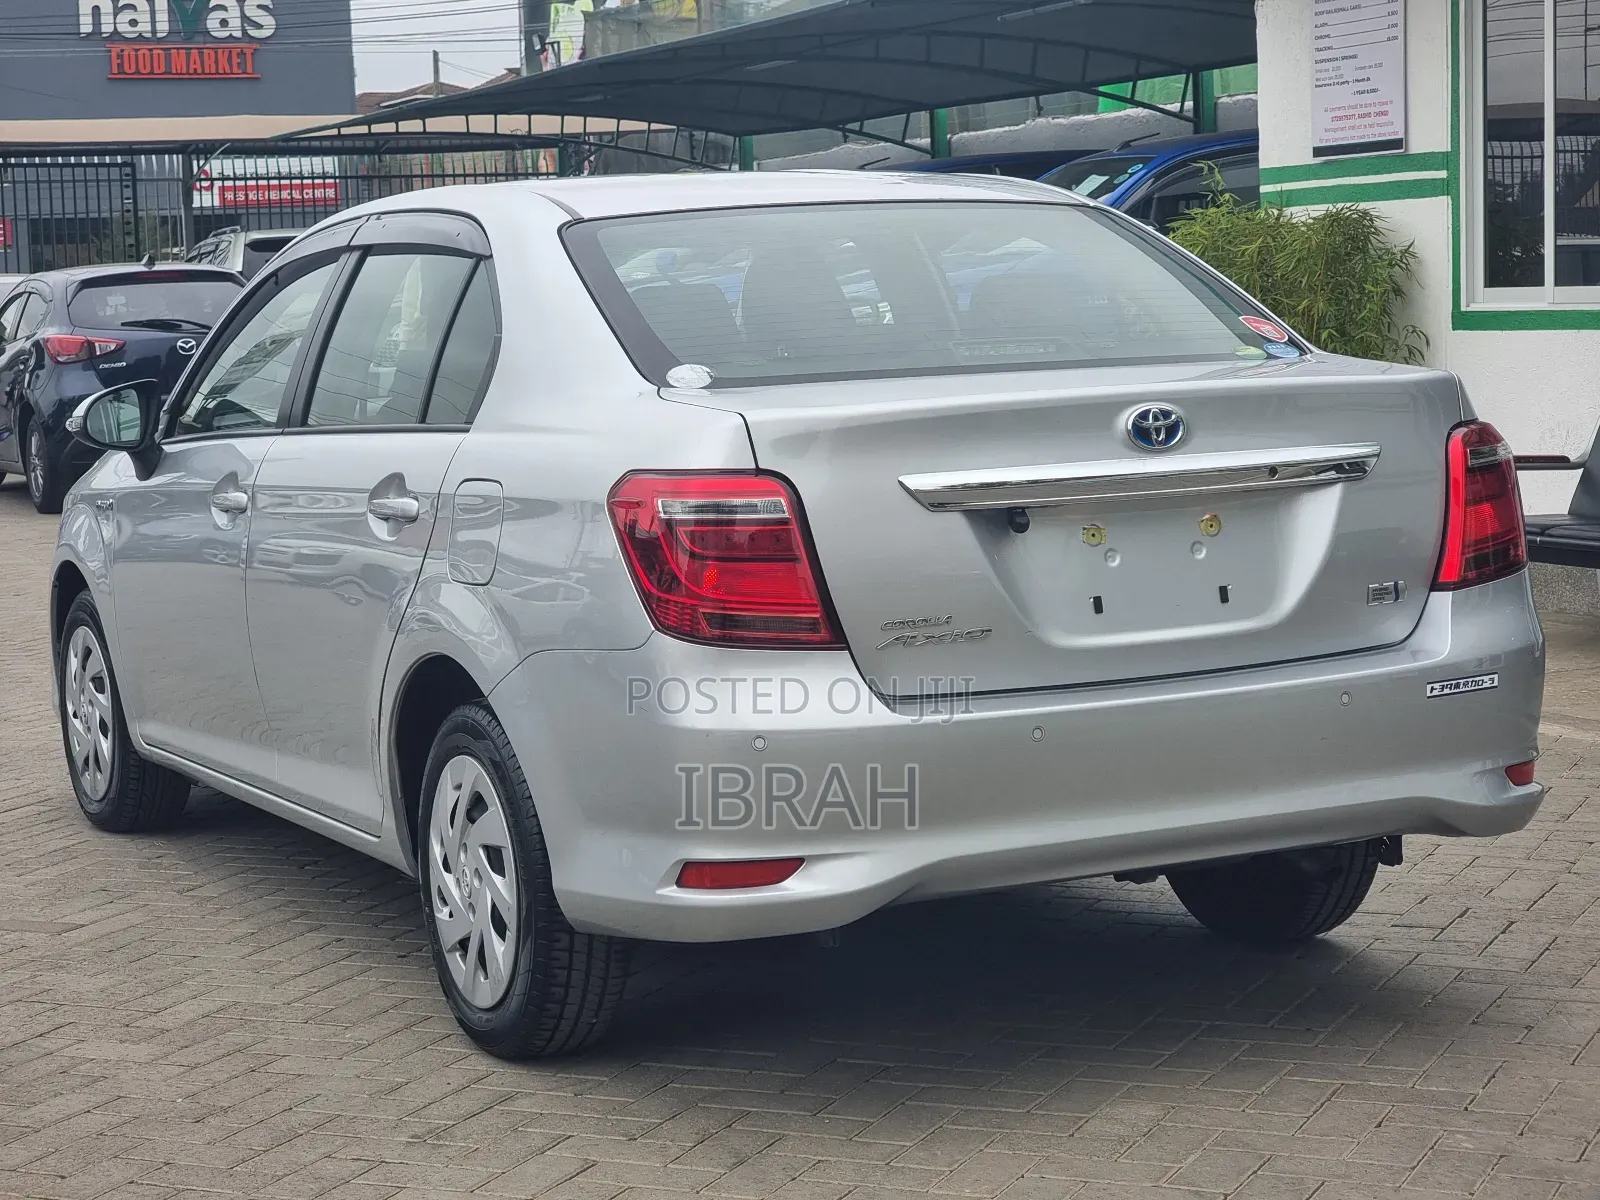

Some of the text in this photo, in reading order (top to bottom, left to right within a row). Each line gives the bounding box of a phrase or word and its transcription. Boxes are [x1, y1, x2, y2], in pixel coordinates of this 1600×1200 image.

[111, 48, 254, 74] FOOD MARKET
[223, 190, 264, 201] PRESIGE
[303, 188, 335, 199] CENTRE
[881, 614, 953, 630] COROLLA
[1429, 677, 1495, 694] トヨタ東京カローラ
